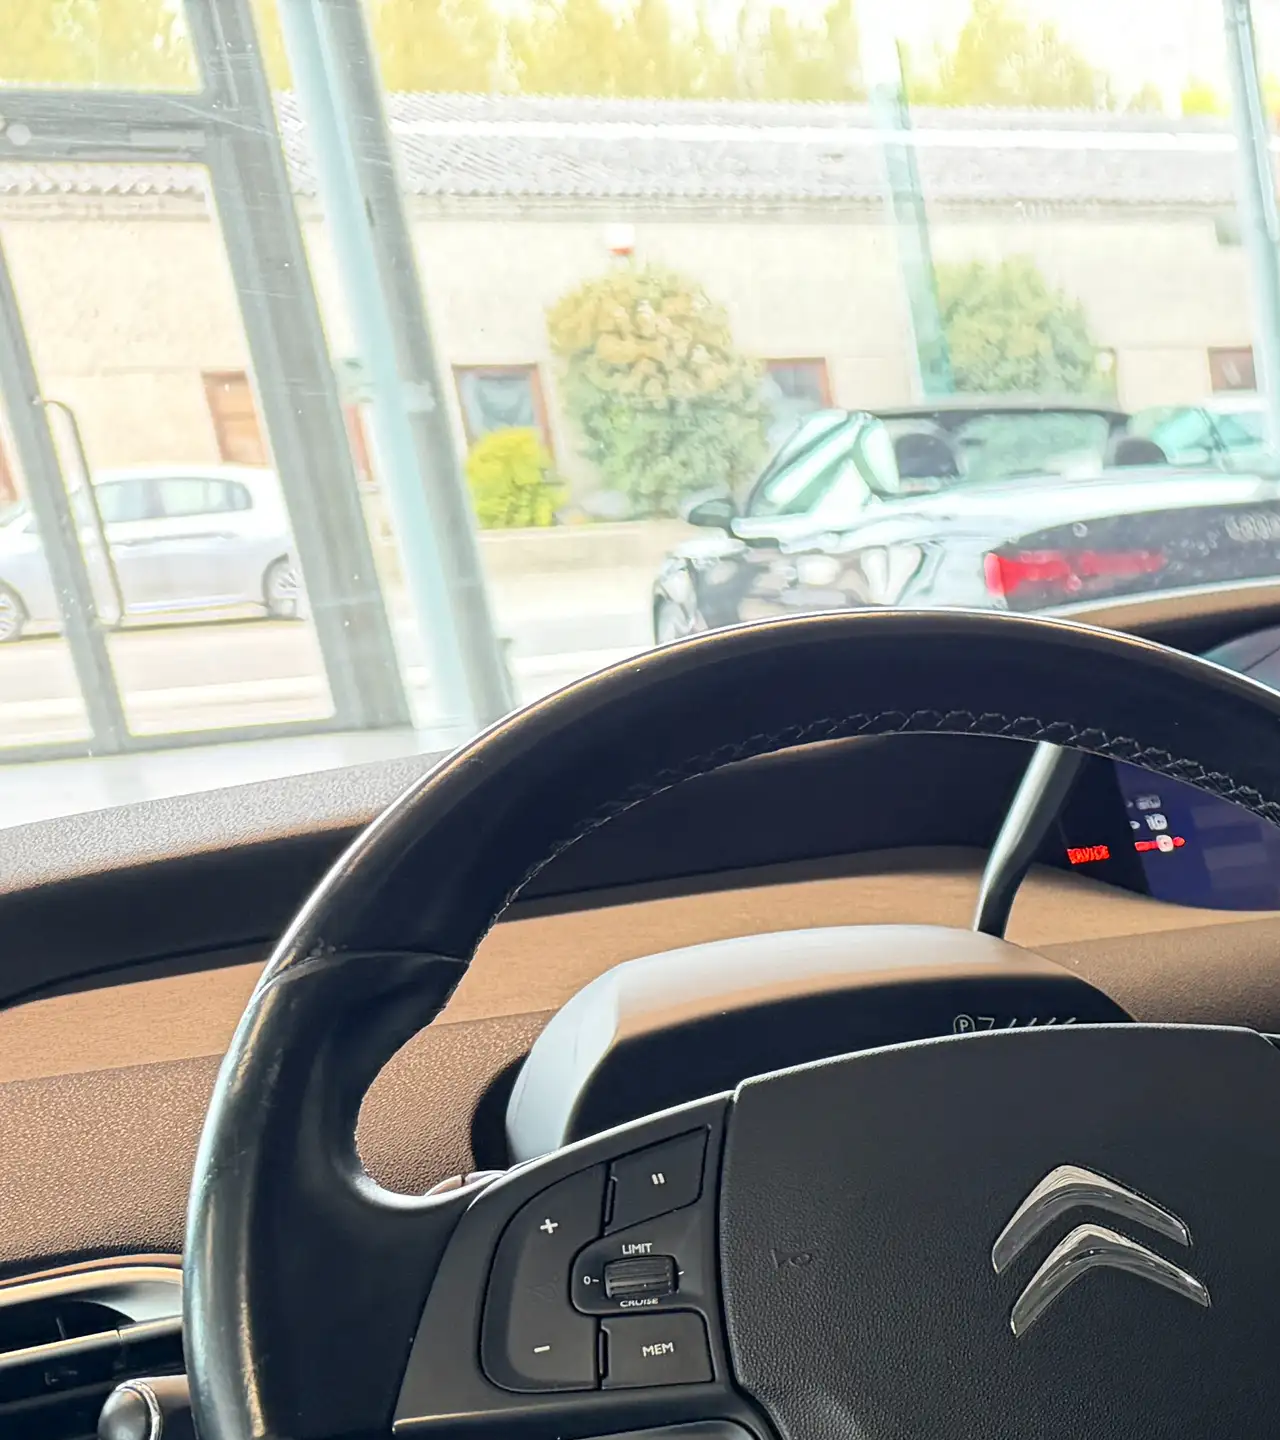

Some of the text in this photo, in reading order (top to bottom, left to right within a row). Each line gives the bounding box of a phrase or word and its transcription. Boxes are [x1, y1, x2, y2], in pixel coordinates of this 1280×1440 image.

[621, 1242, 653, 1255] LIMIT
[619, 1297, 660, 1308] CRUISE
[641, 1341, 675, 1358] MEM
